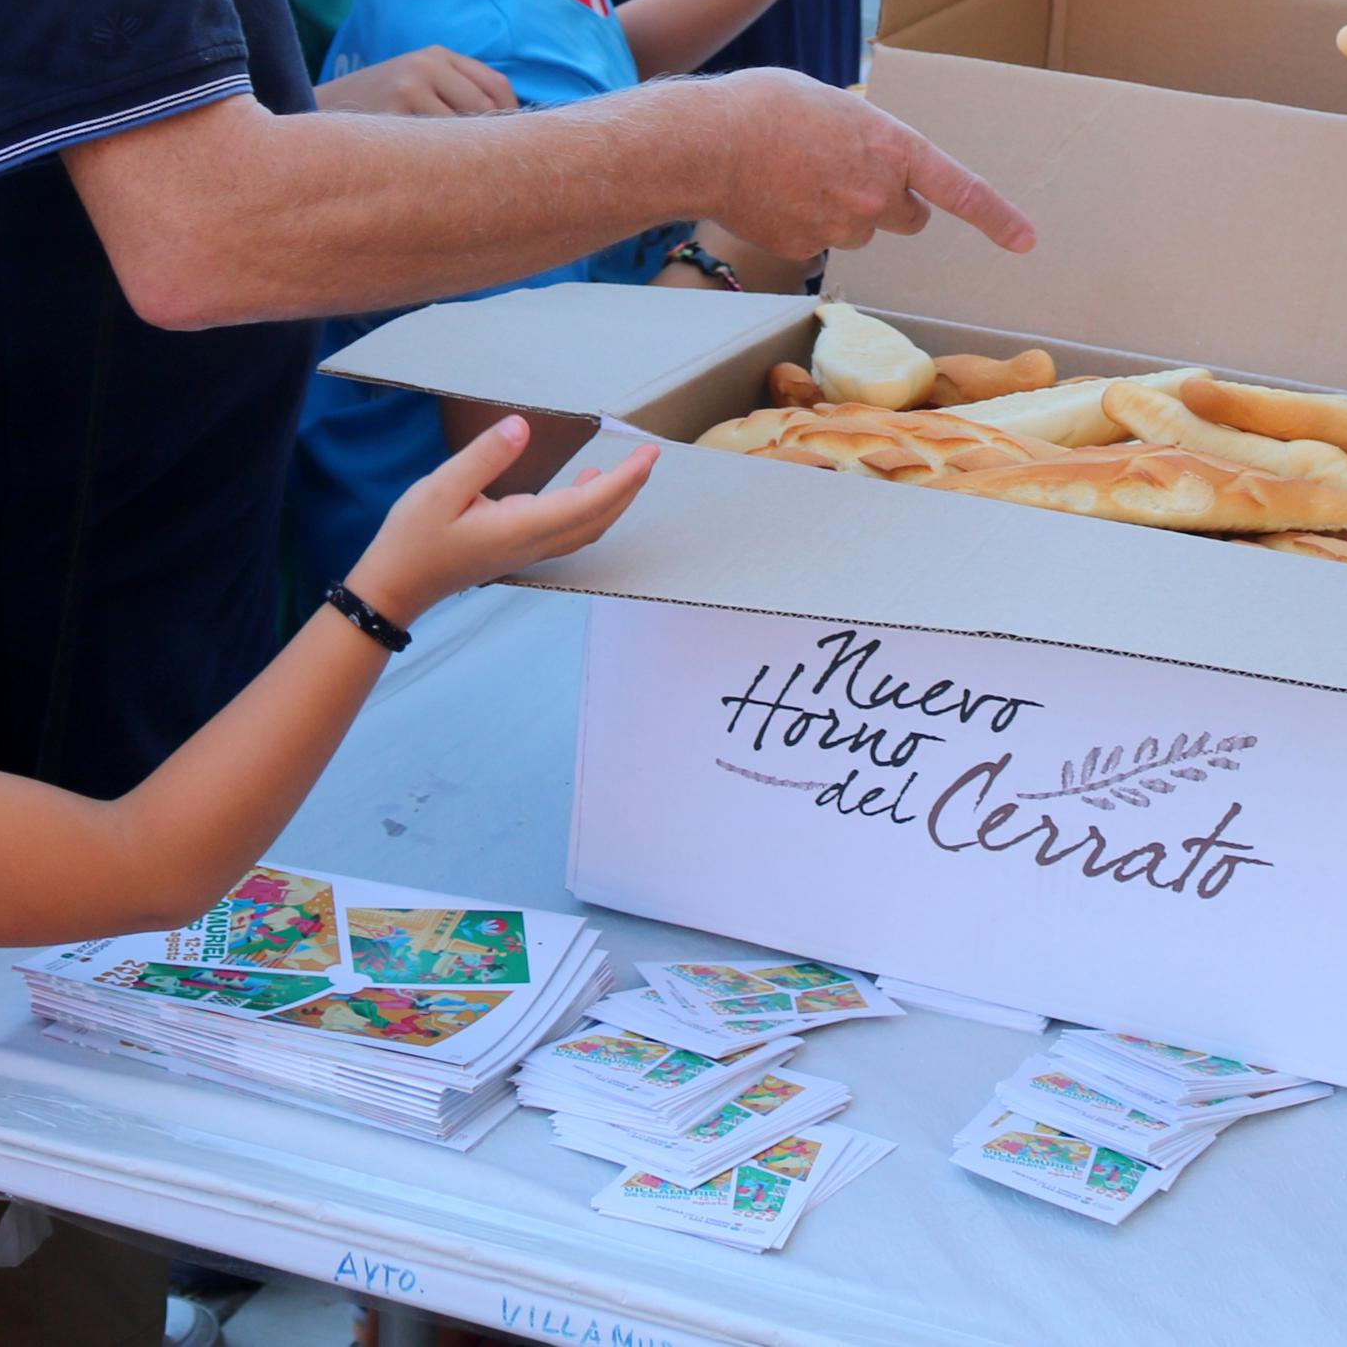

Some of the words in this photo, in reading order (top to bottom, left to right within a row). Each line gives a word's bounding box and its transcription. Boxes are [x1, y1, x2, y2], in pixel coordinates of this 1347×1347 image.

[816, 629, 1045, 733] Nuevo
[721, 662, 946, 768] Horno
[815, 769, 917, 824] del
[927, 752, 1274, 899] Cerrato
[164, 931, 181, 961] agosto
[201, 900, 230, 963] AMURIEL
[623, 1186, 728, 1198] VILLAMURIEL
[334, 1251, 425, 1294] AYTO.
[502, 1296, 673, 1347] VILLAM
